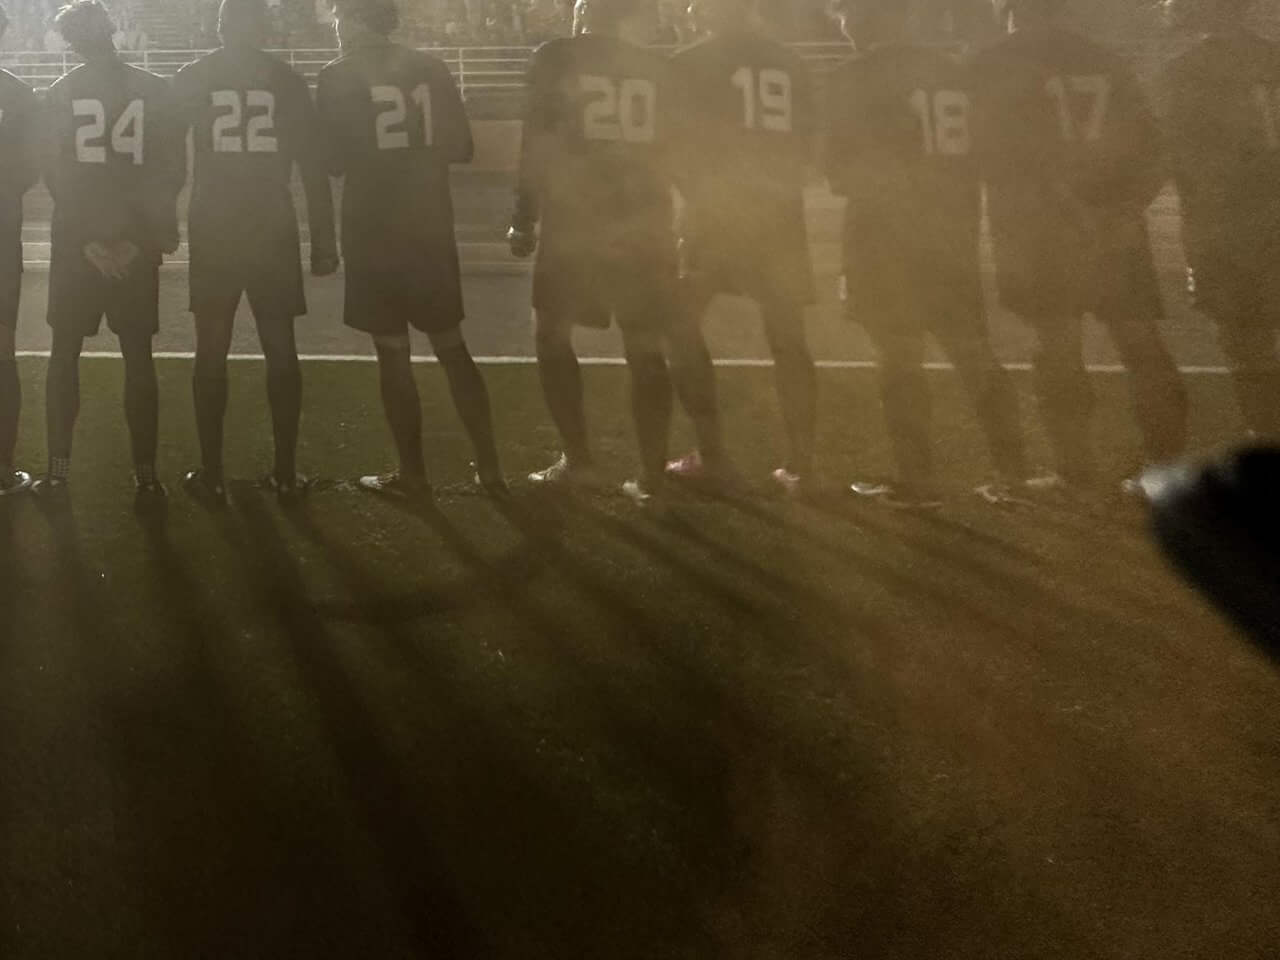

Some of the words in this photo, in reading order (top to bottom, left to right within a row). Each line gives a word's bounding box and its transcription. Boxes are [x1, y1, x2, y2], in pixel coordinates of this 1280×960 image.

[72, 99, 144, 164] 24
[211, 91, 278, 152] 22
[371, 85, 433, 149] 21
[579, 75, 656, 141] 20
[732, 67, 792, 131] 19
[910, 89, 970, 154] 18
[1045, 75, 1110, 141] 17
[1252, 83, 1280, 148] 1
